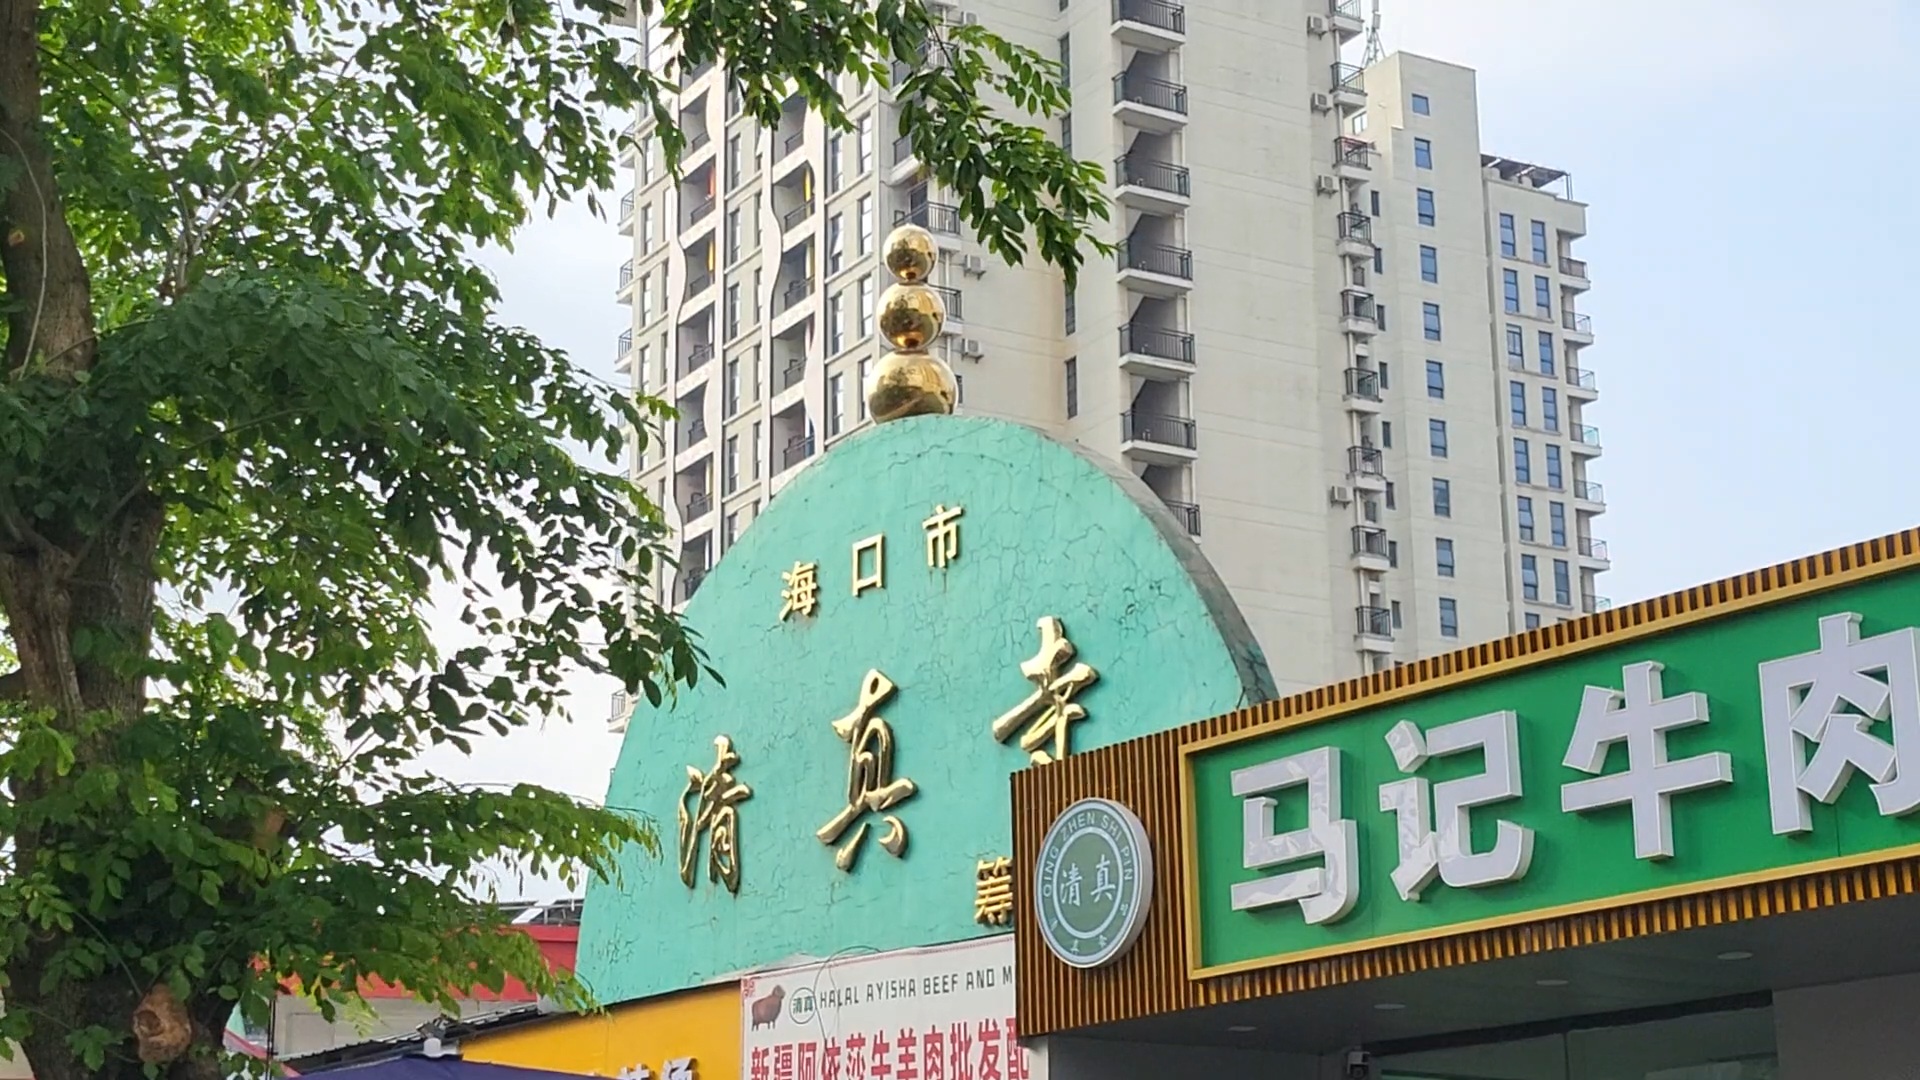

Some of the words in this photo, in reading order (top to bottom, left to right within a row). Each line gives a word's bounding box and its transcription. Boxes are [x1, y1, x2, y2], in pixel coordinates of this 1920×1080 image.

[780, 505, 965, 621] 海口市
[678, 615, 1098, 894] 清真寺
[1230, 611, 1920, 925] 马记牛肉
[1060, 853, 1116, 907] 清真
[1061, 812, 1096, 842] ZHEN
[1101, 814, 1122, 841] SHI
[1120, 845, 1133, 880] PIN
[820, 987, 859, 1009] HALAL
[866, 979, 916, 1003] AYISHA
[923, 973, 958, 995] BEEF
[966, 968, 995, 990] AND
